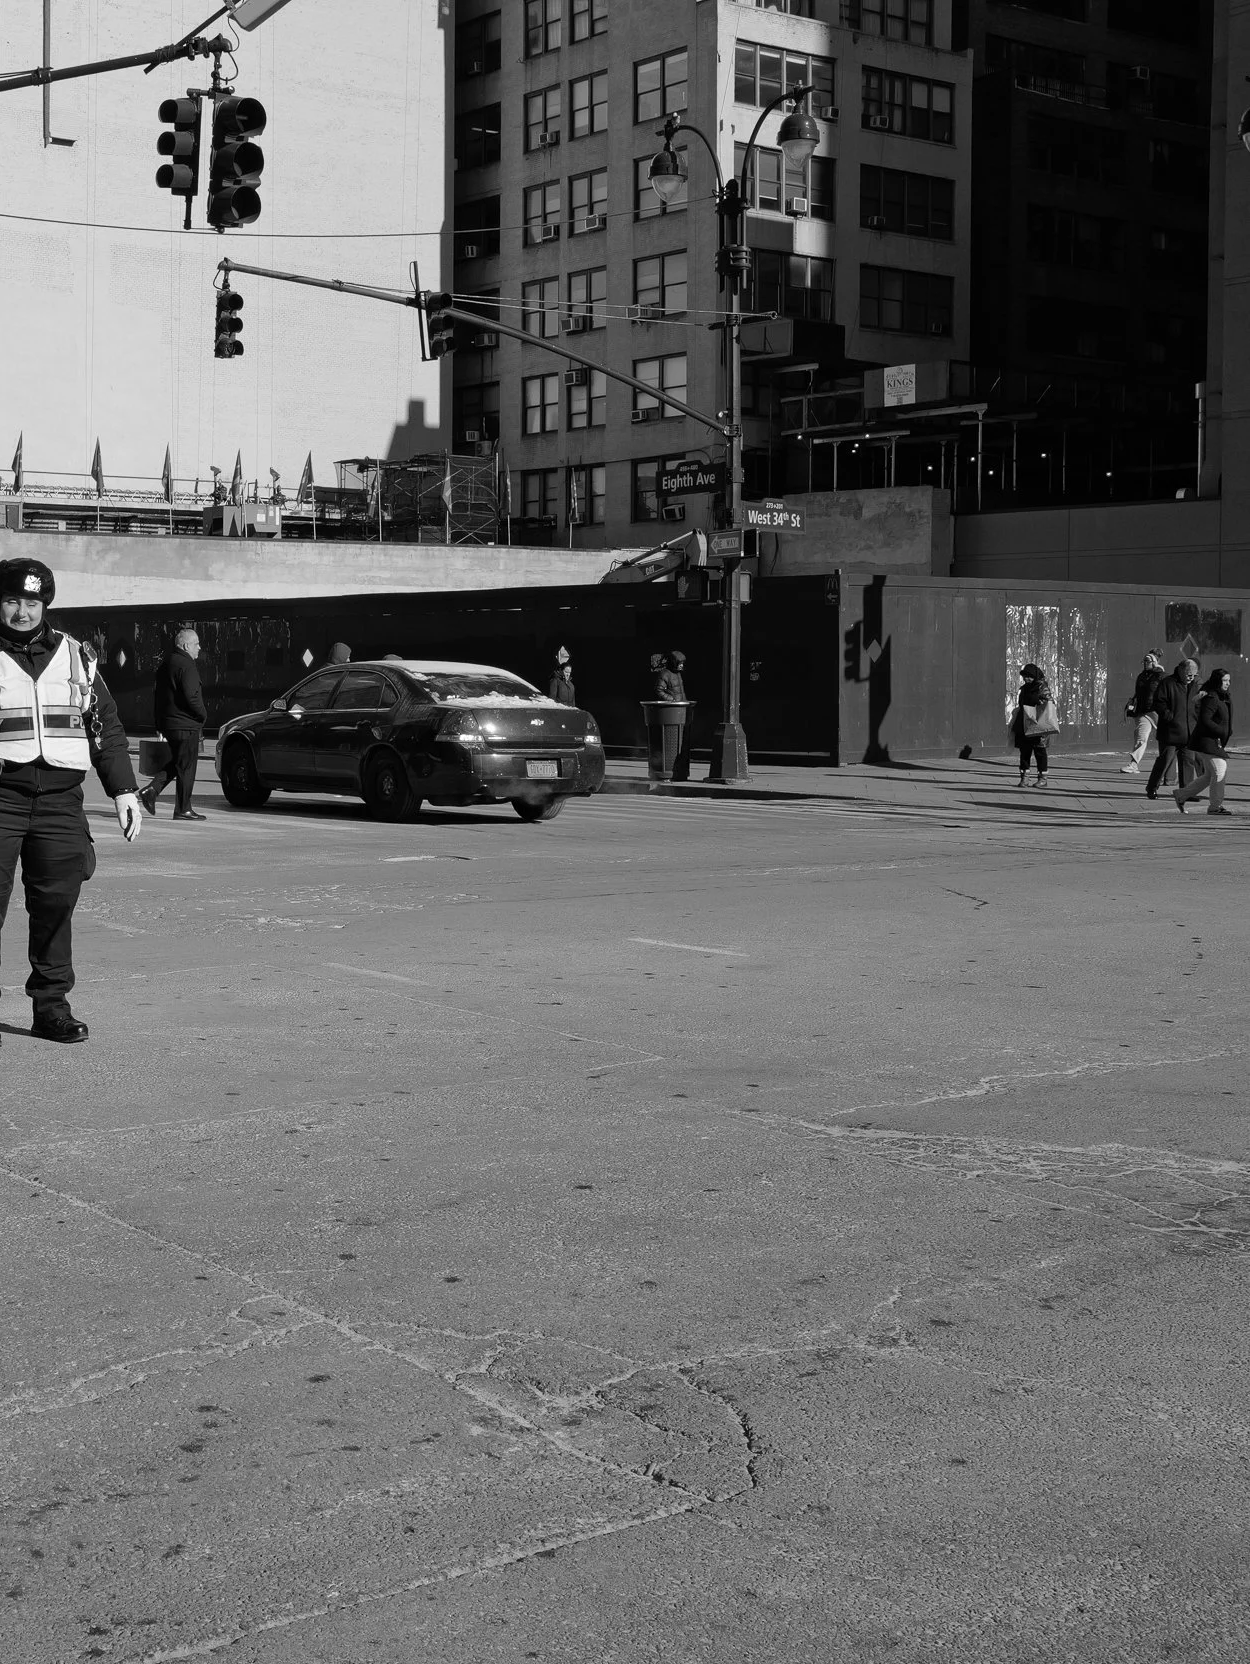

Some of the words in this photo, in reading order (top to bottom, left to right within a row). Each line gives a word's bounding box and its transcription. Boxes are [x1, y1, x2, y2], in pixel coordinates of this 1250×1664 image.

[887, 378, 913, 388] KINGS
[661, 471, 694, 493] Eighth
[695, 471, 716, 486] Ave
[748, 509, 771, 526] West
[772, 511, 789, 526] 34th
[790, 513, 801, 528] St
[713, 539, 724, 550] ONE
[726, 537, 738, 549] WAY
